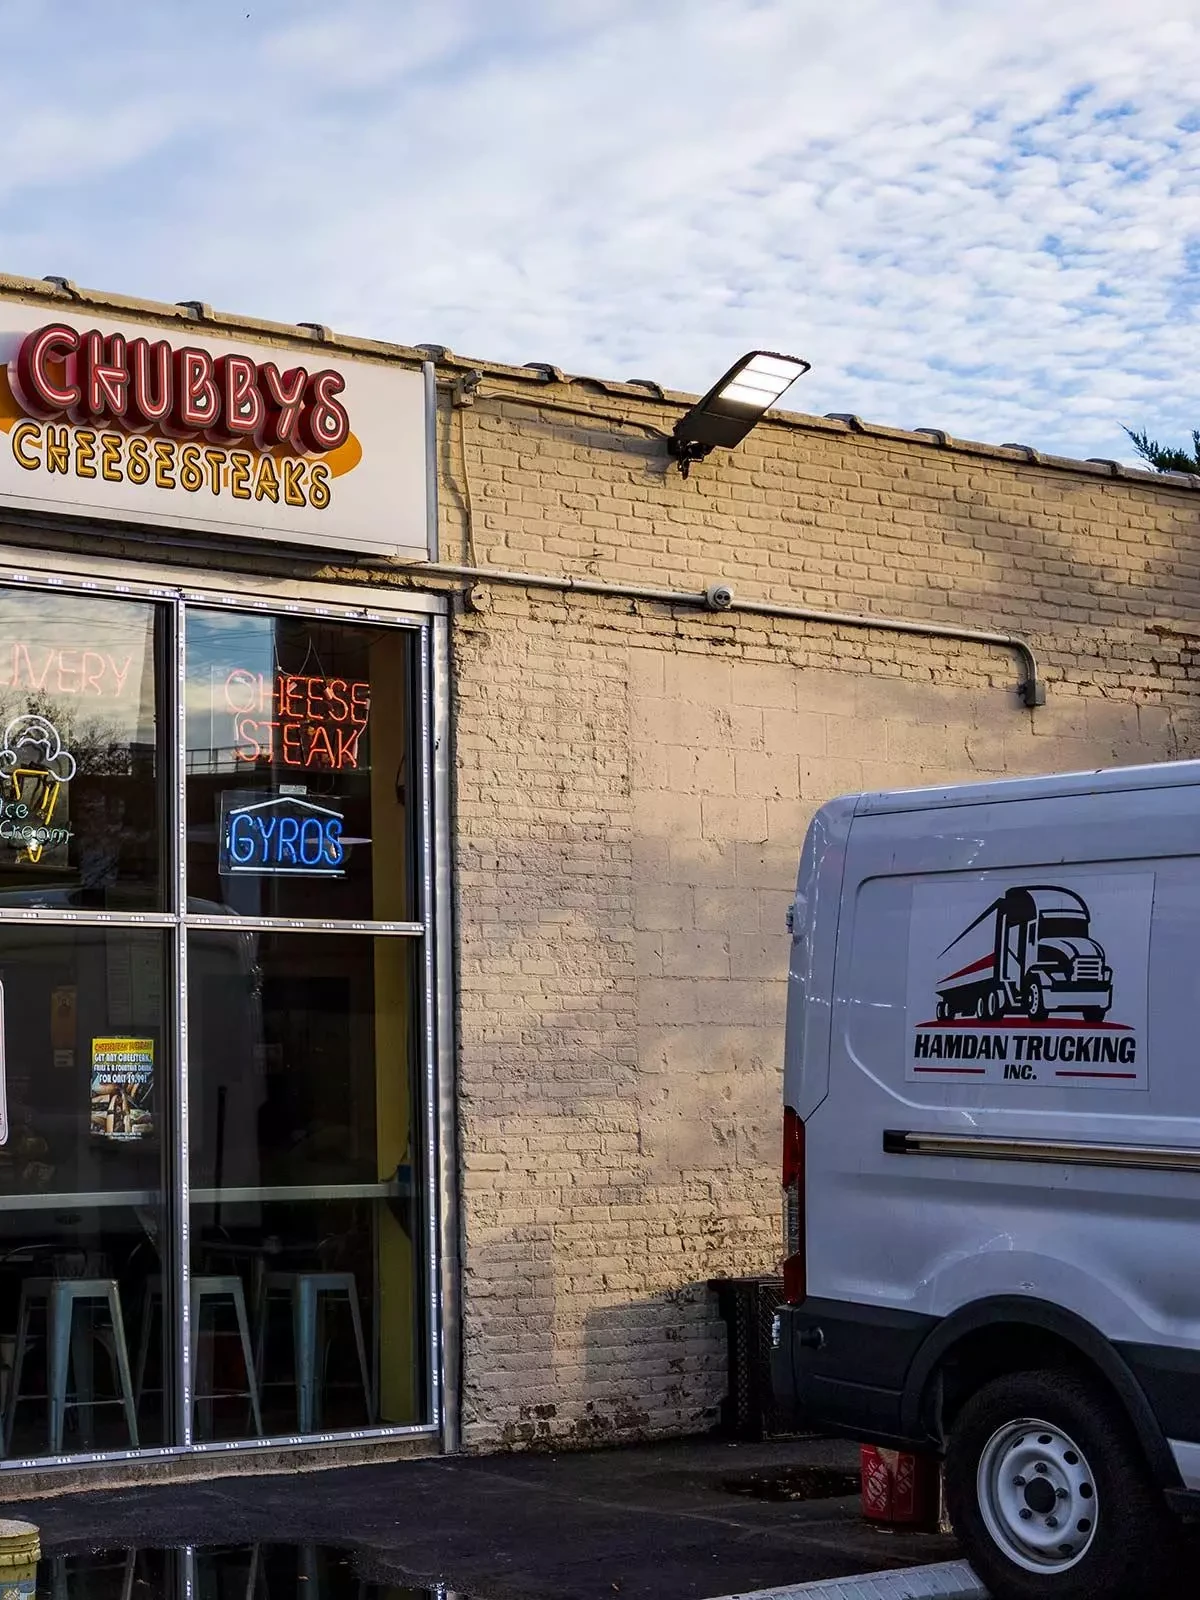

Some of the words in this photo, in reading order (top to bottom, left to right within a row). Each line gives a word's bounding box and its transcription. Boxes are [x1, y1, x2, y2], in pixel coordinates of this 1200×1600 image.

[10, 323, 351, 453] CHUBBYS
[12, 420, 332, 509] CHEESESTEAKS
[225, 669, 371, 723] CHEESE
[235, 719, 358, 768] STEAK
[0, 819, 70, 844] Cream
[230, 814, 343, 865] GYROS
[914, 1034, 1008, 1060] HAMDAN
[1013, 1035, 1136, 1064] TRUCKING
[1003, 1064, 1037, 1080] INC.
